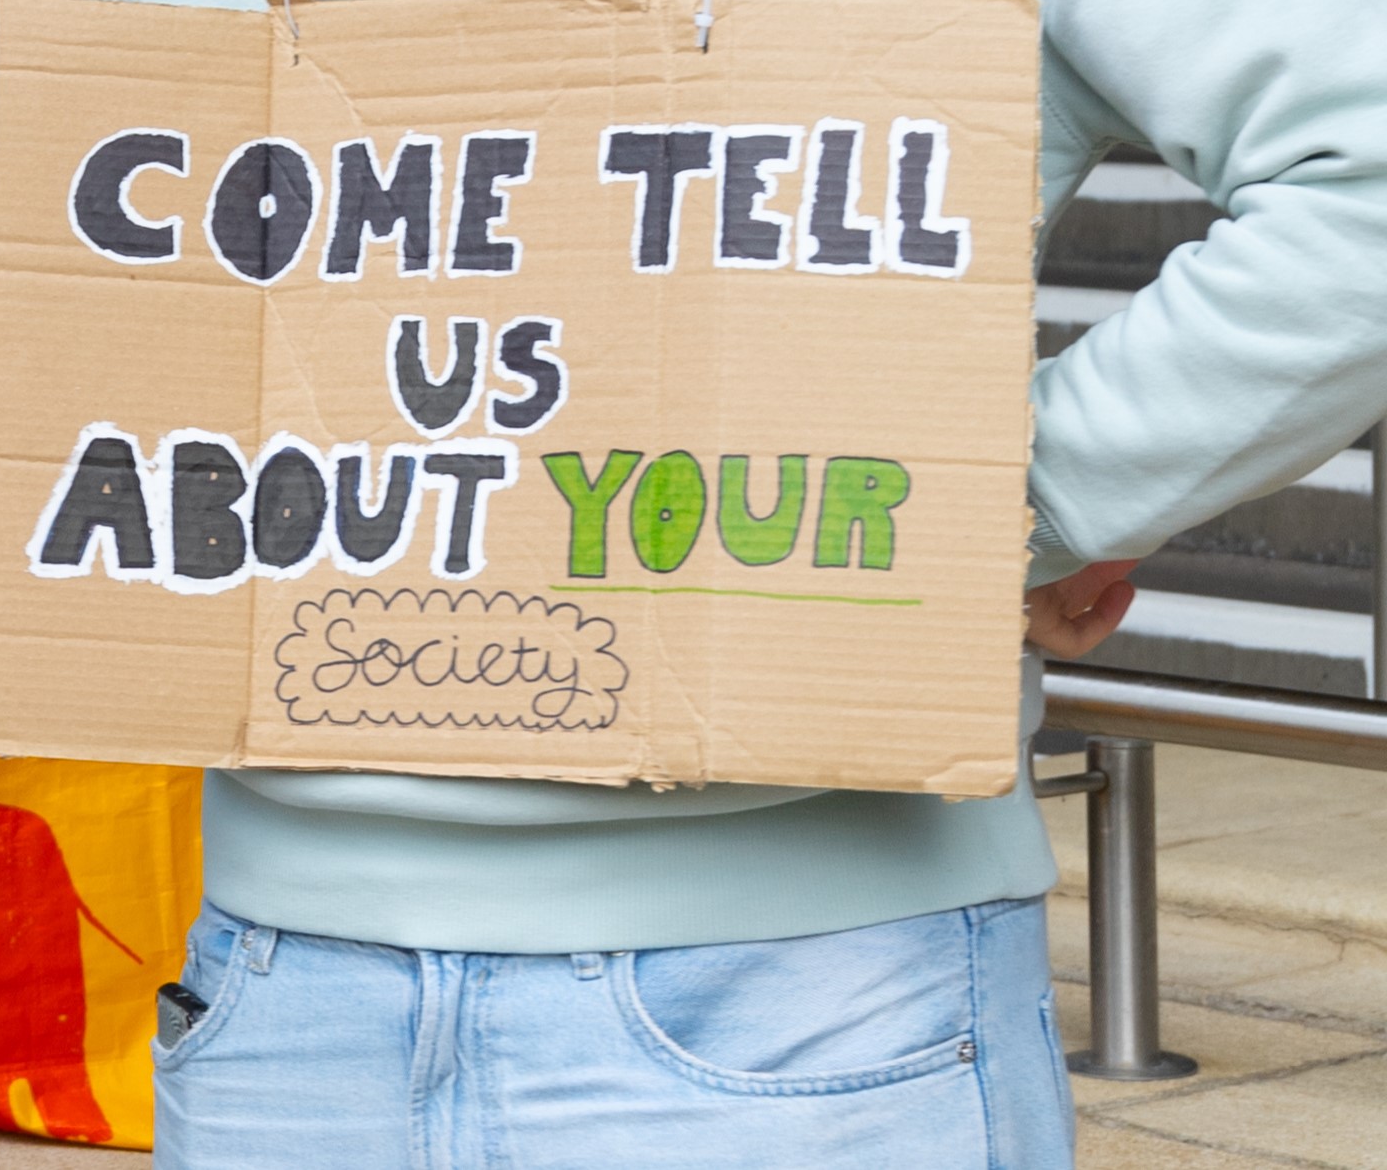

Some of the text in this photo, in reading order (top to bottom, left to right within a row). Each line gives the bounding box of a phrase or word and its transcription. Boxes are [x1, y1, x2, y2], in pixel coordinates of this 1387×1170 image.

[67, 116, 974, 287] COME TELL
[385, 313, 571, 440] US
[26, 420, 911, 596] ABOUT YOUR
[312, 617, 594, 718] Society
